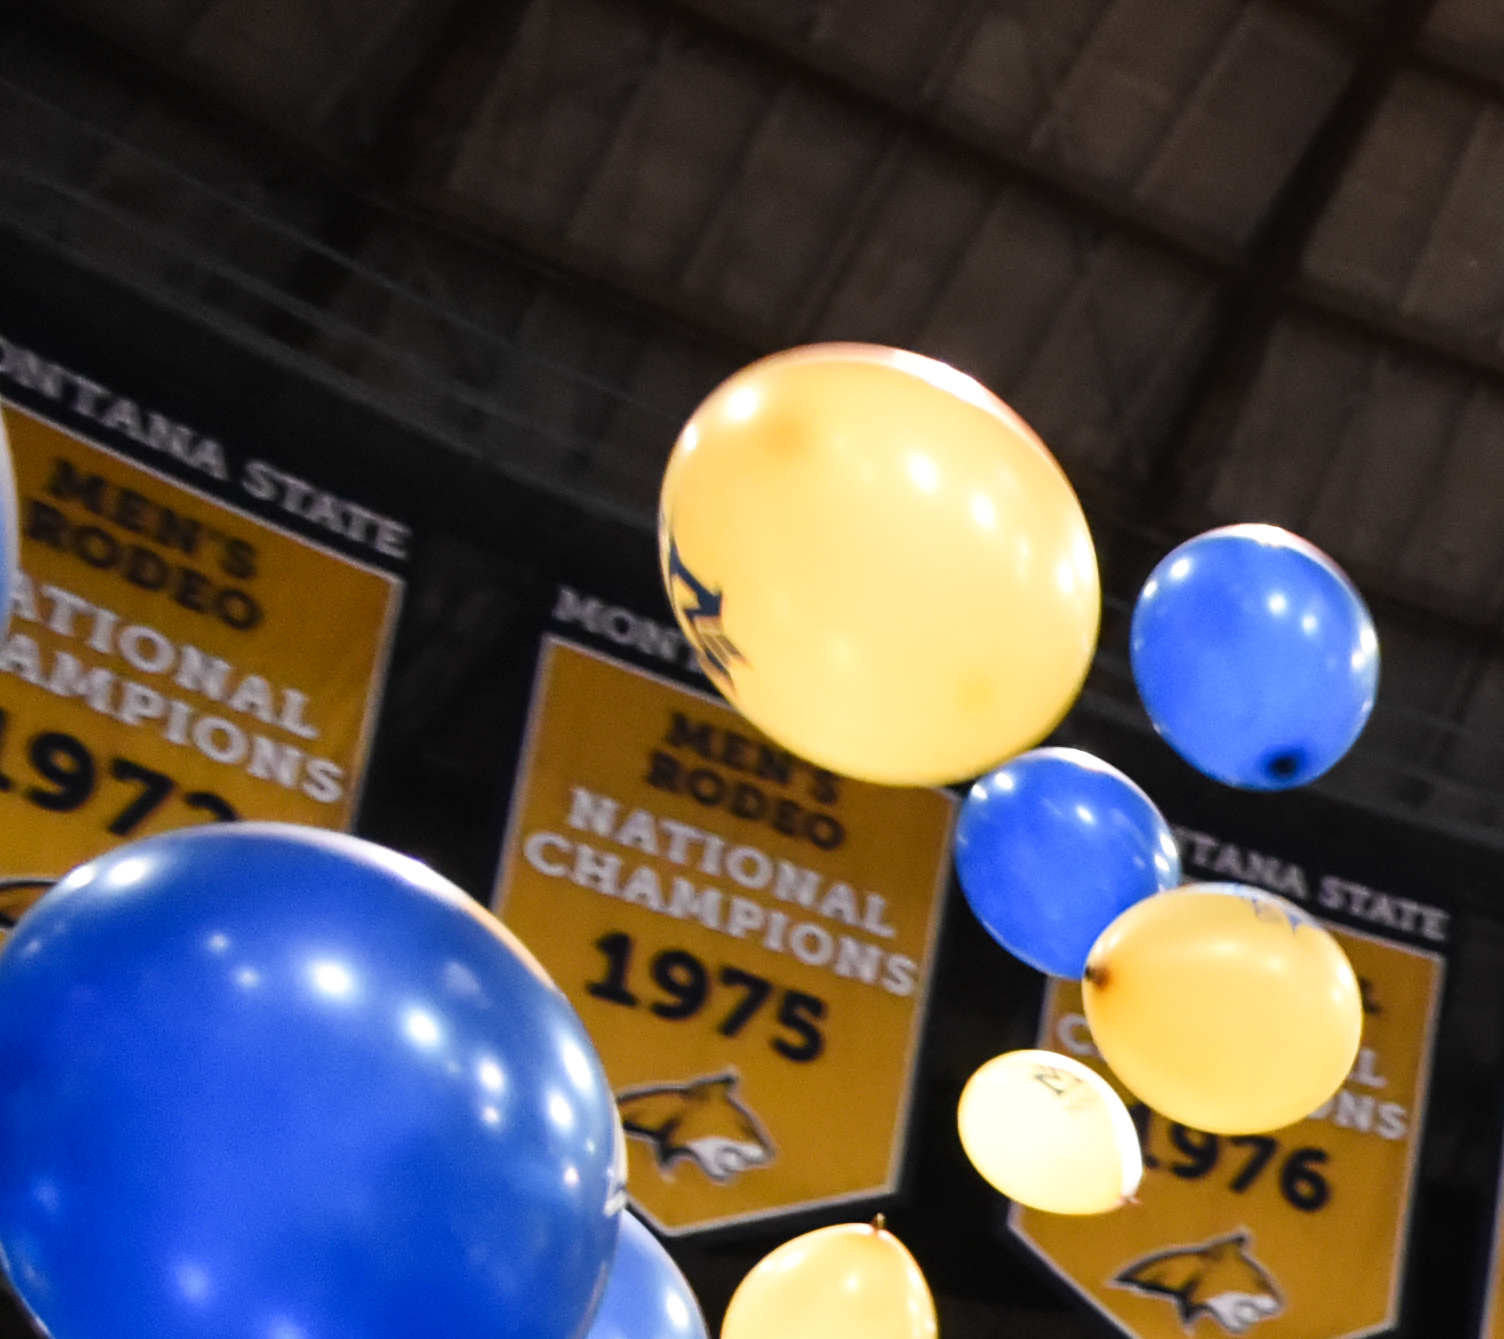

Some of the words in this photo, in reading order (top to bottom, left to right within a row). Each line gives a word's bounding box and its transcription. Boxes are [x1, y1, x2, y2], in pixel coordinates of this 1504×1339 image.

[25, 499, 265, 632] RODEO
[240, 457, 411, 561] STATE
[567, 786, 898, 938] NATIONAL
[647, 750, 848, 852] RODEO
[523, 830, 919, 998] CHAMPIONS
[1317, 875, 1451, 942] STATE
[586, 930, 829, 1063] 1975
